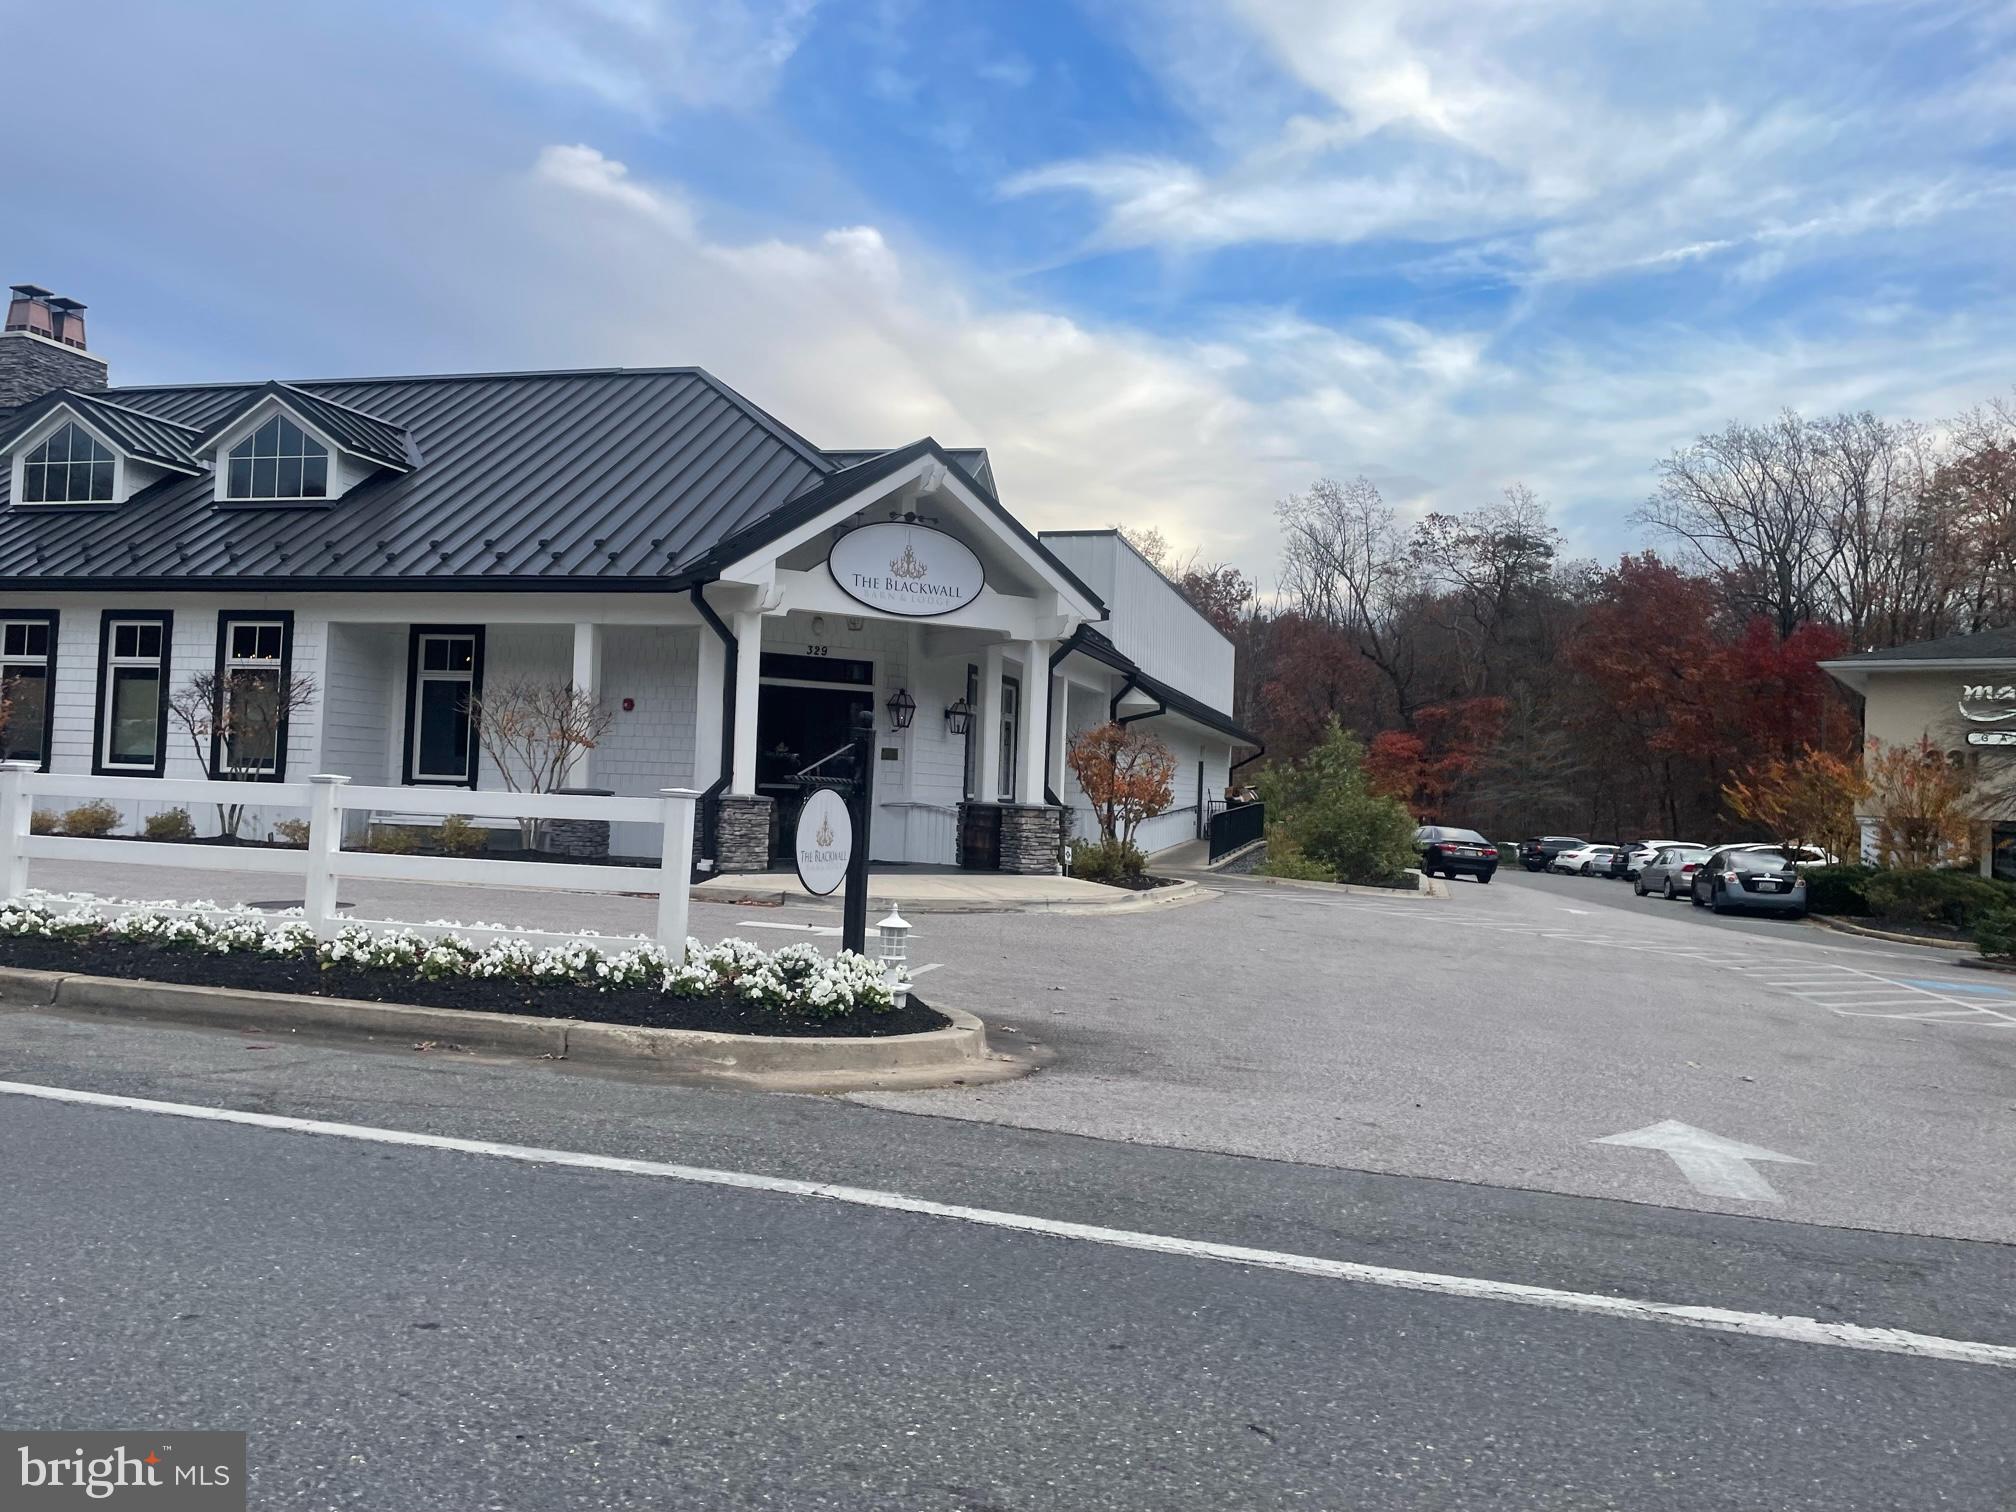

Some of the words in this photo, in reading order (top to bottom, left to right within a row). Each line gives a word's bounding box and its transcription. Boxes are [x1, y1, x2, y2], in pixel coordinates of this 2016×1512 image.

[852, 573, 880, 590] THE
[885, 577, 962, 598] BLACKWALL
[806, 645, 828, 656] 329
